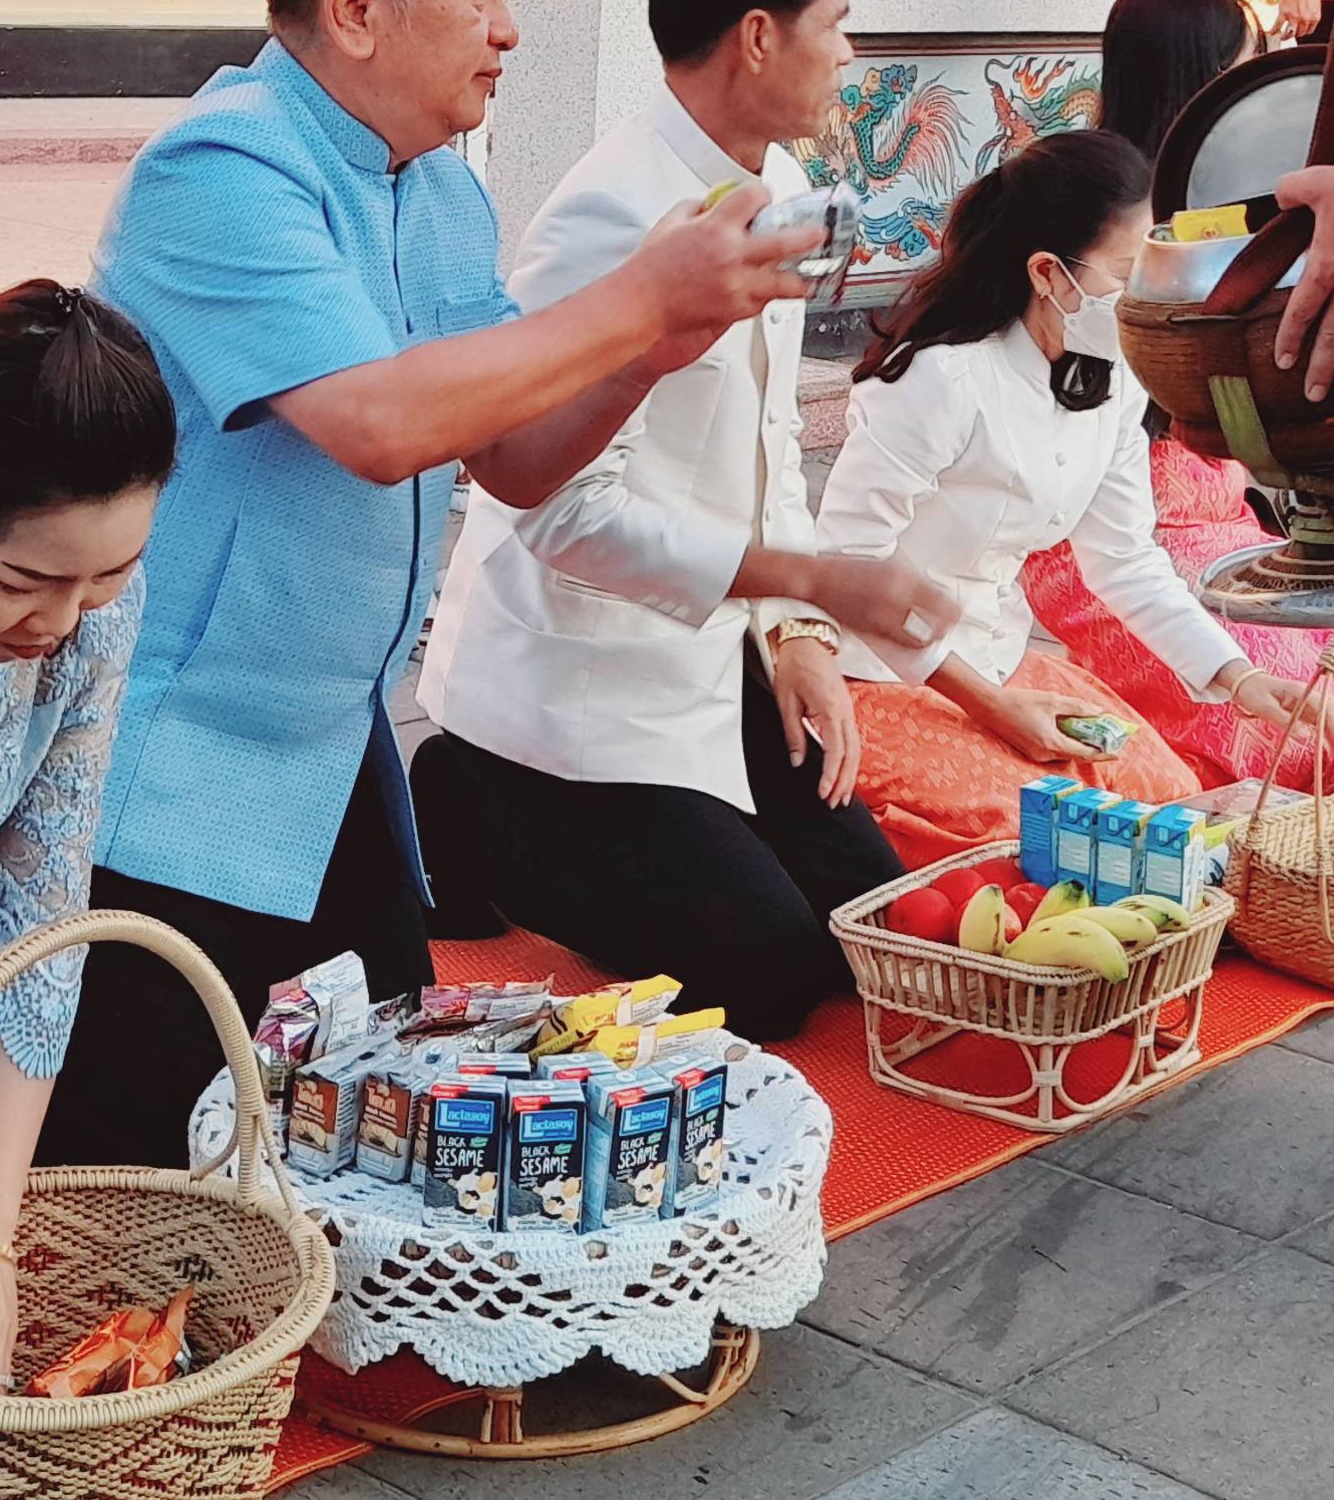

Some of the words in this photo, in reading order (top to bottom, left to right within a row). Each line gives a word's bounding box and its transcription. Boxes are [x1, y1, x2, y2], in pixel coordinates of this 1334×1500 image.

[434, 1148, 485, 1168] SESAME
[519, 1156, 570, 1177] SESAME
[617, 1144, 660, 1170] SESAME
